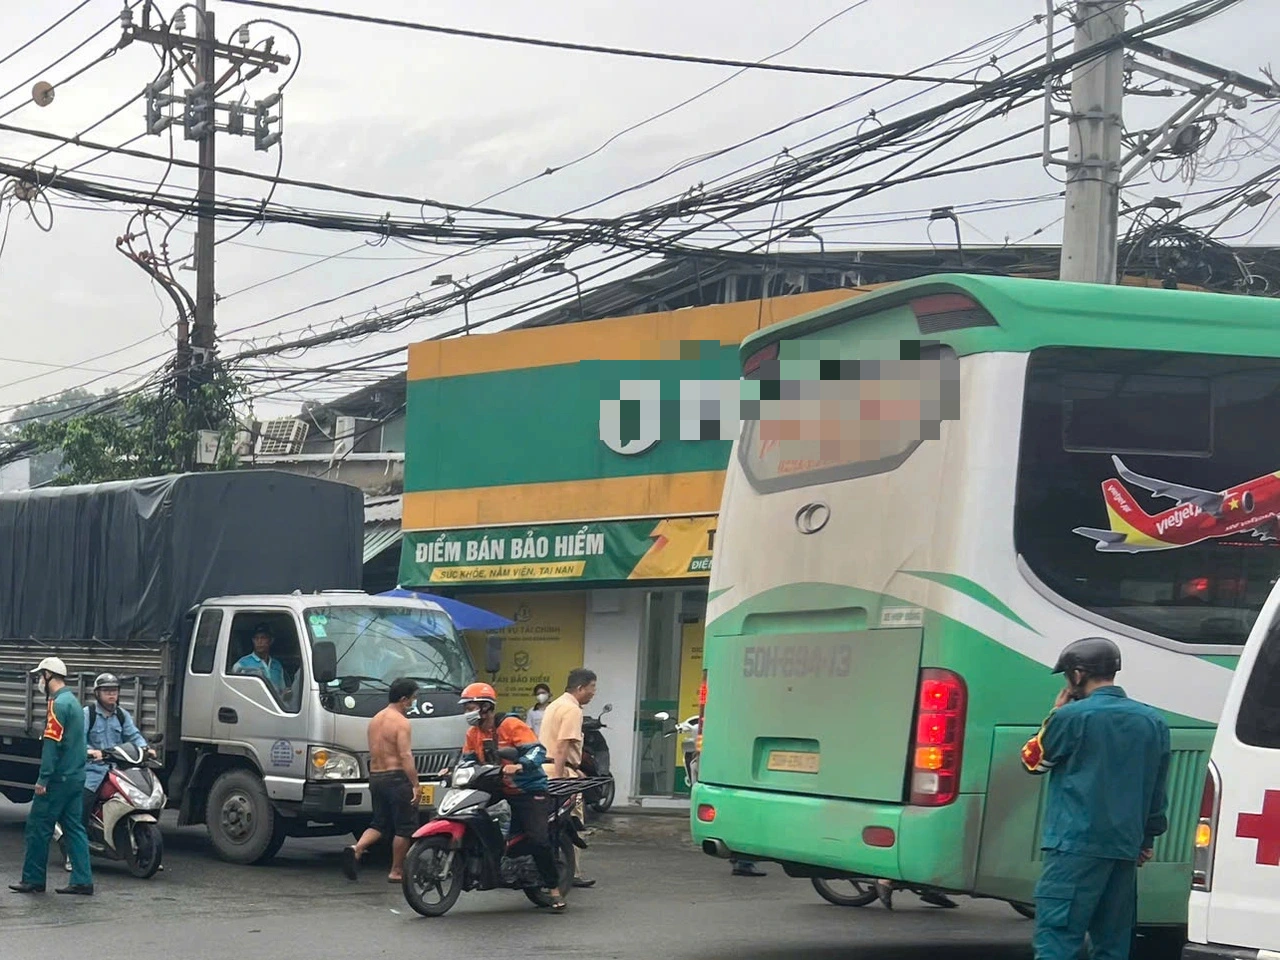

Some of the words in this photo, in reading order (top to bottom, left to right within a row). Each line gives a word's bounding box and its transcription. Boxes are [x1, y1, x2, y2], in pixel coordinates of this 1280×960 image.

[415, 534, 462, 563] ĐIỂM
[466, 536, 505, 561] BÁN
[510, 531, 549, 559] BẢO
[555, 525, 605, 557] HIỂM
